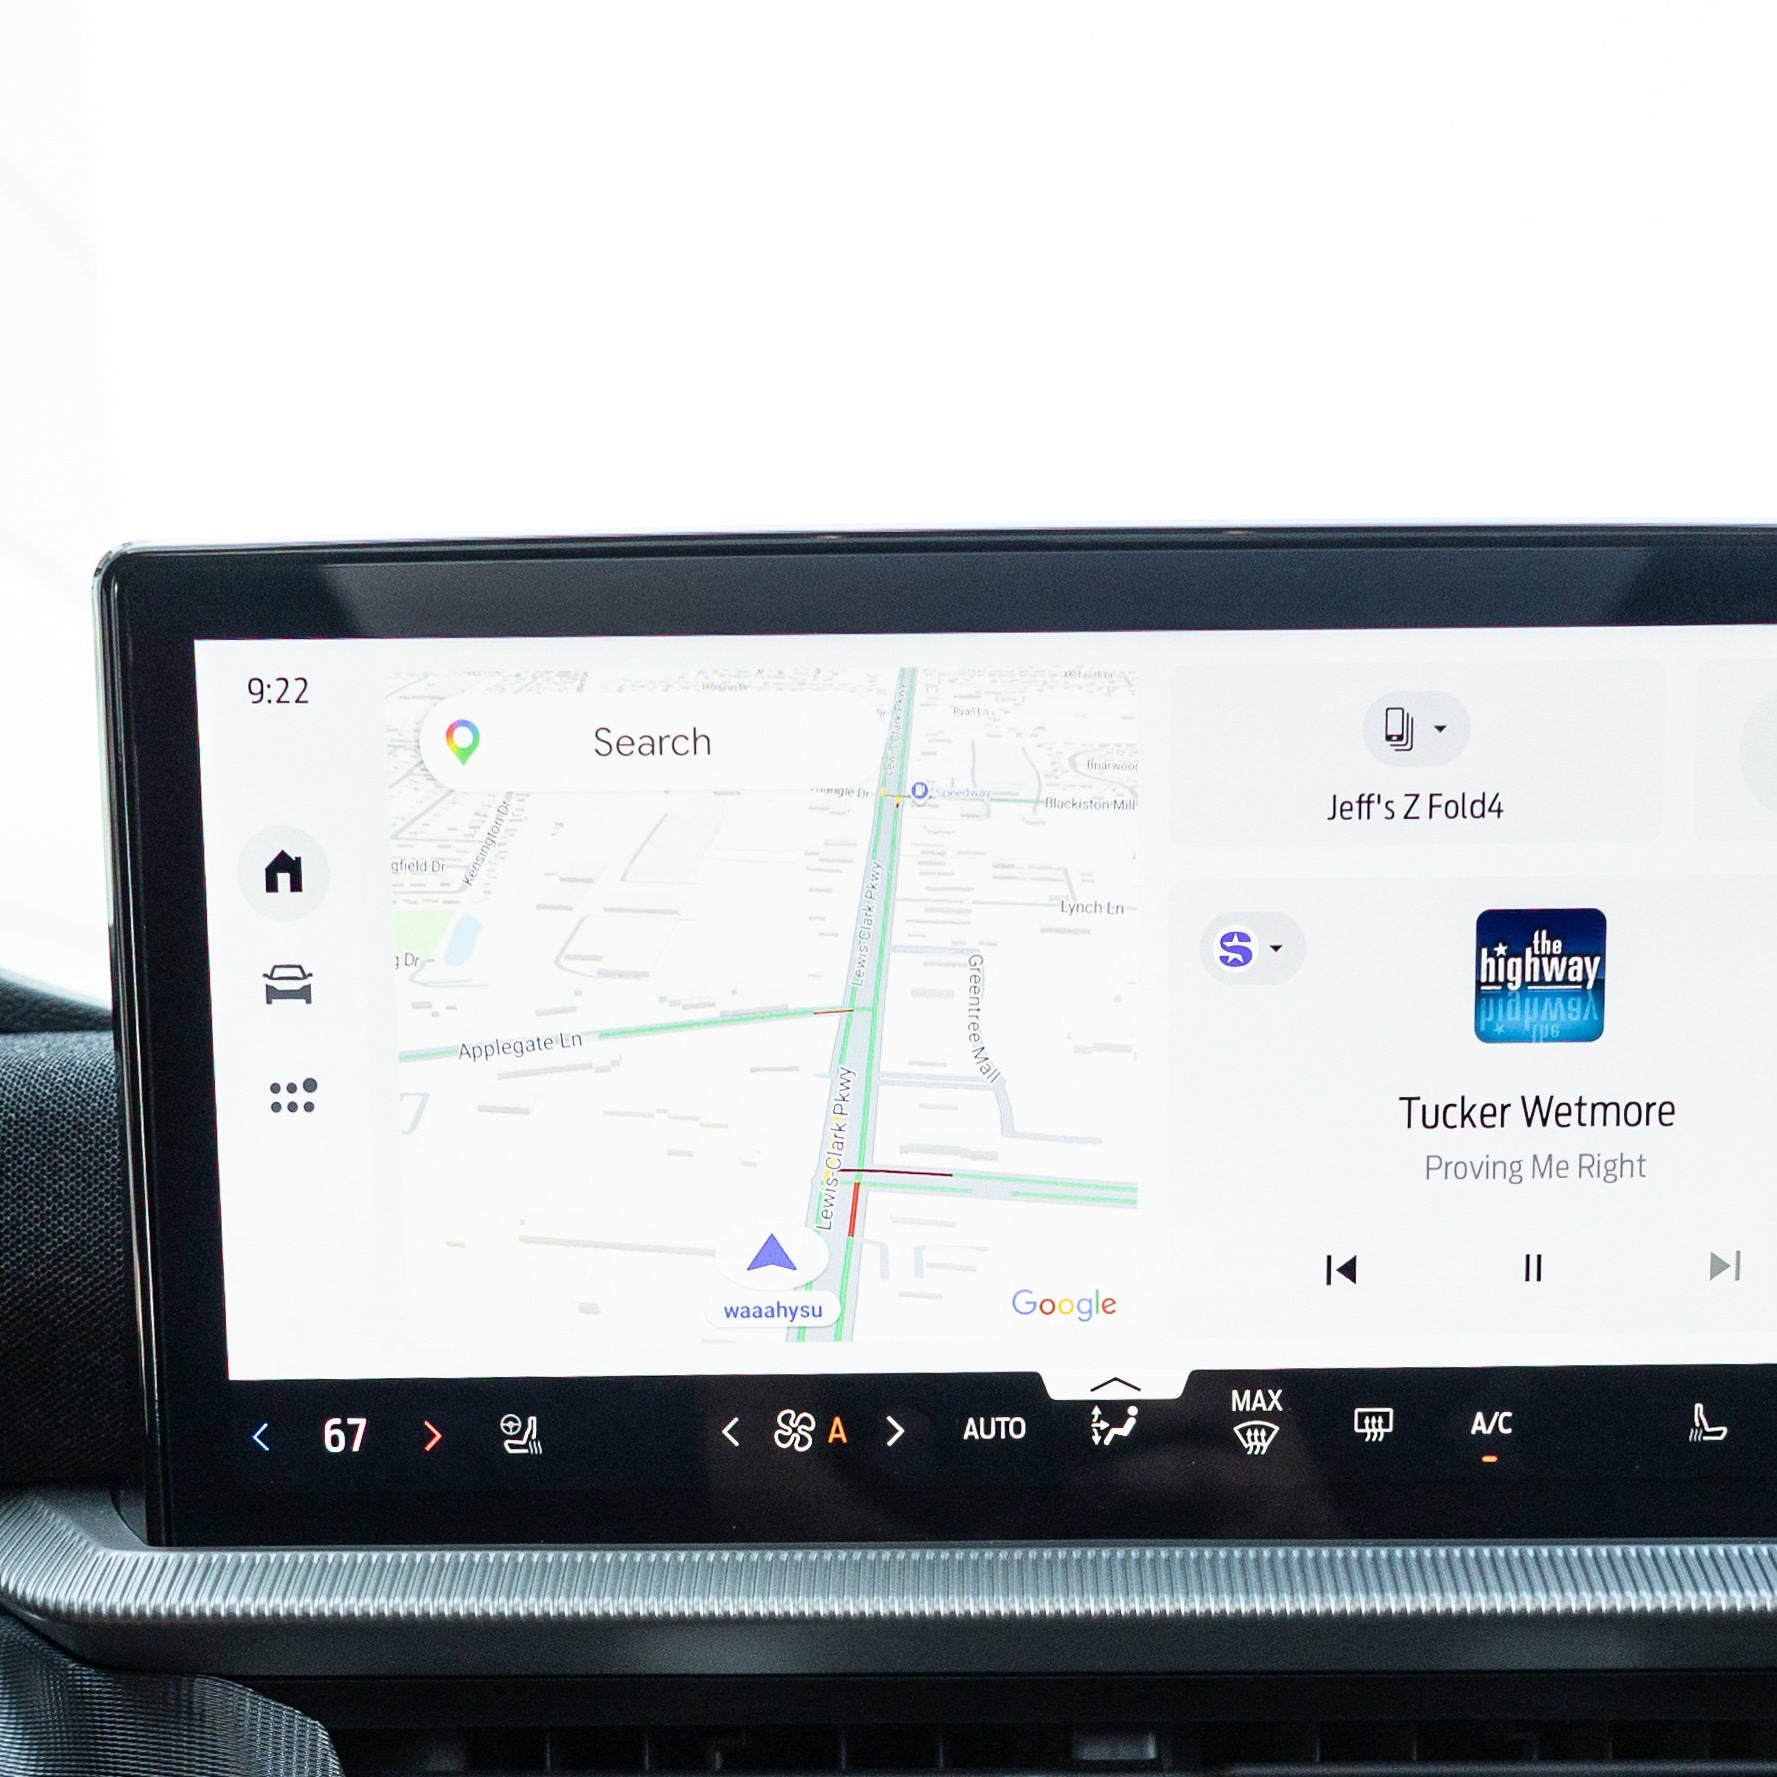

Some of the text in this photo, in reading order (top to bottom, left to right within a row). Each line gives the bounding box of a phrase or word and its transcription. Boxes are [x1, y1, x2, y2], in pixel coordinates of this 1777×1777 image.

[247, 676, 310, 705] 9:22
[594, 726, 711, 757] Search
[935, 786, 992, 800] Speedway
[1044, 797, 1136, 811] Blackiston Mill
[1327, 792, 1504, 821] Jeff's Z Fold4
[462, 800, 513, 886] Kensington Dr
[391, 858, 447, 874] gfield Dr
[864, 861, 884, 901] Pkwy
[1060, 900, 1125, 916] Lynch Ln
[1532, 929, 1562, 955] the
[404, 952, 420, 967] Dr
[1480, 943, 1601, 990] highway
[967, 954, 1002, 1084] Greentree Mall
[458, 1032, 583, 1060] Applegate Ln
[1399, 1093, 1676, 1129] Tucker Wetmore
[816, 1066, 856, 1230] Lewis-Clark Pkwy
[1425, 1152, 1647, 1184] Proving Me Right
[723, 1300, 823, 1324] waaahysu
[1011, 1289, 1117, 1323] Google
[1231, 1389, 1283, 1412] MAX
[323, 1417, 367, 1453] 67
[827, 1415, 848, 1444] A
[964, 1415, 1027, 1442] AUTO
[1470, 1411, 1513, 1436] A/C
